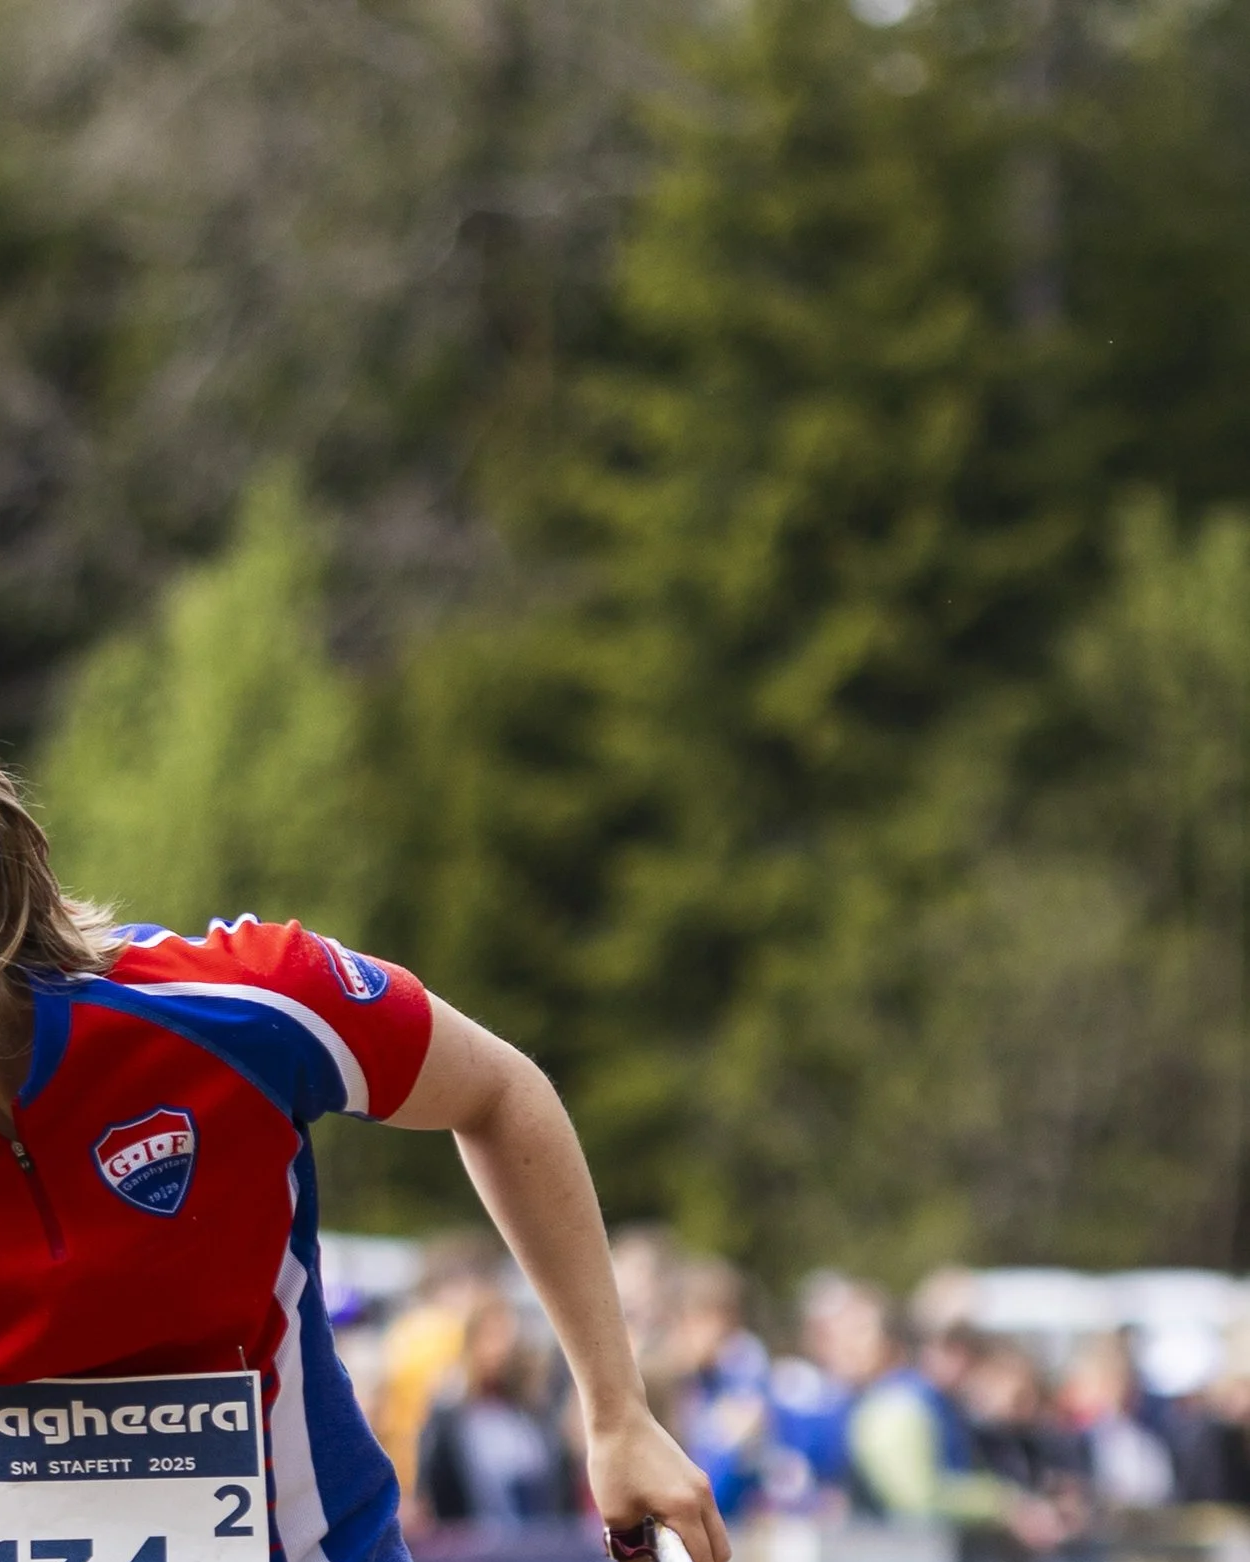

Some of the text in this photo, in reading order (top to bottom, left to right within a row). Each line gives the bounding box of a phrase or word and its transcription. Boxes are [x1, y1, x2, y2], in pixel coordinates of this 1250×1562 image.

[10, 1456, 196, 1475] SM STAFETT 2025
[214, 1484, 254, 1537] 2
